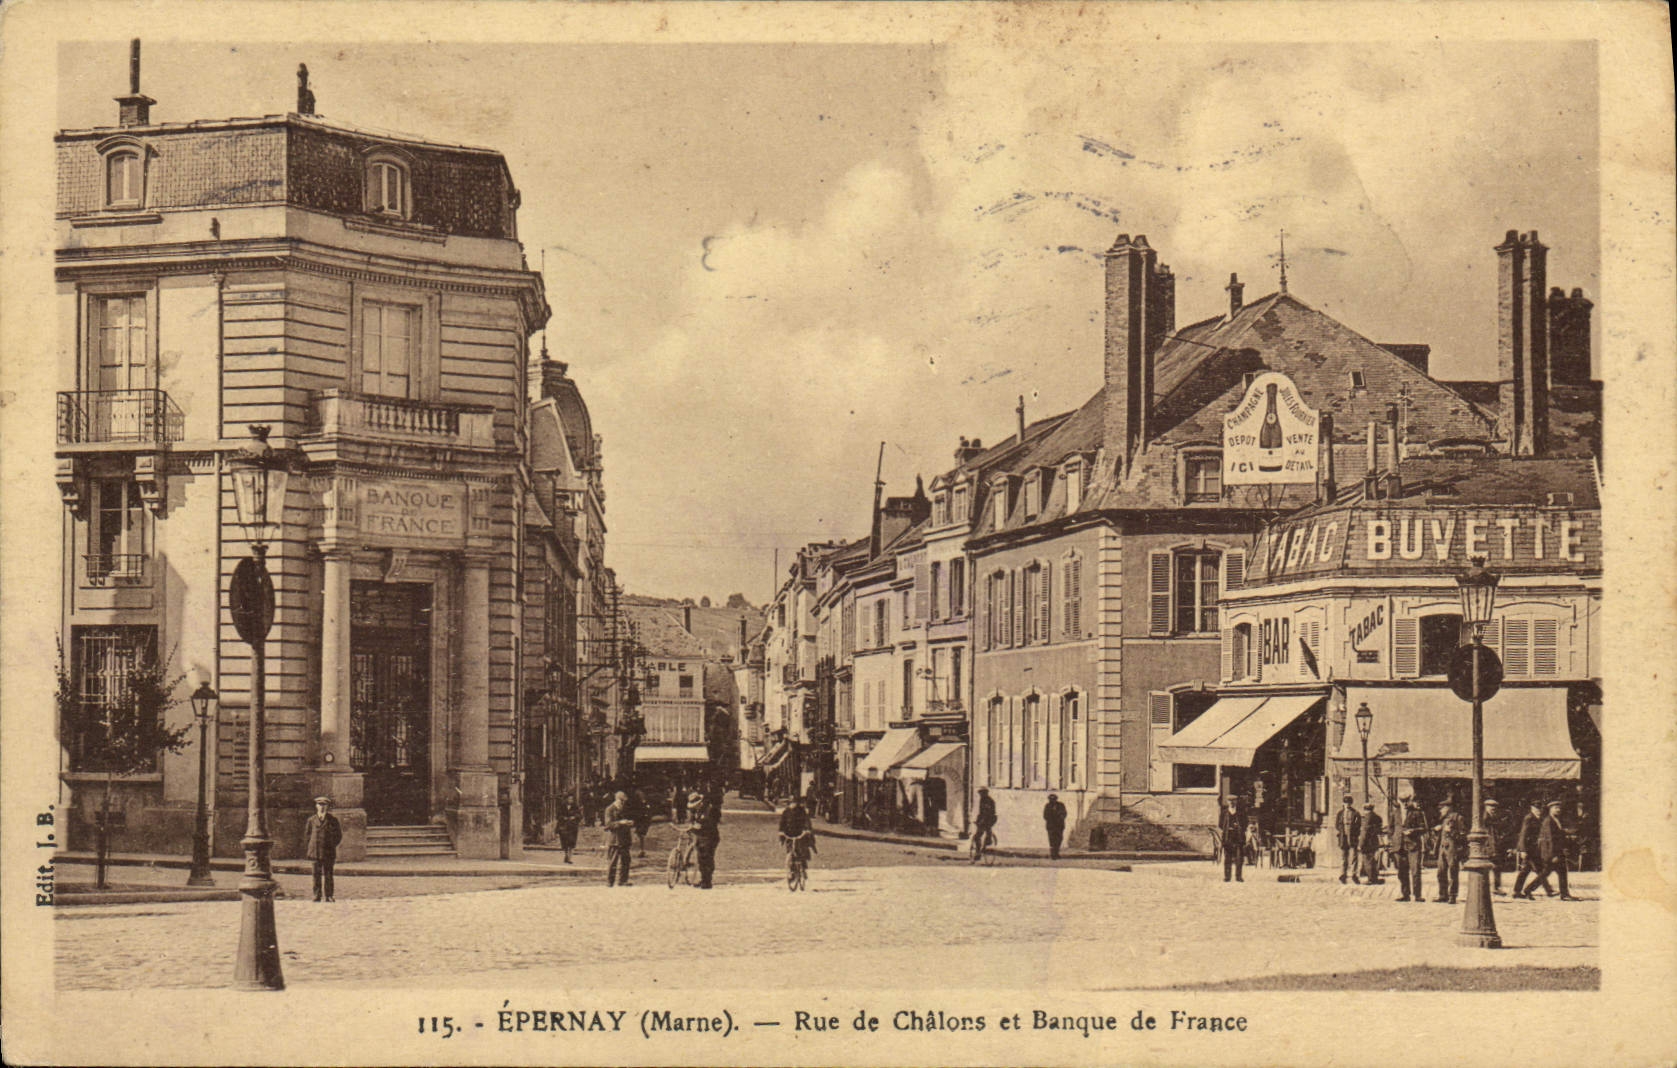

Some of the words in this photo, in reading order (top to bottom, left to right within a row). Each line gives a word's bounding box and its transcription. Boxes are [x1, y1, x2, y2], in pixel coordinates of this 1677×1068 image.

[1227, 387, 1264, 430] CHAMPAGNE
[1286, 433, 1314, 445] VENTE
[1231, 461, 1254, 473] ICI
[367, 488, 455, 509] BANQUE
[367, 515, 455, 535] FRANCE
[1262, 521, 1338, 572] TABAC
[1367, 518, 1585, 563] BUVETTE
[1263, 617, 1290, 665] BAR
[1349, 604, 1384, 652] TABAC
